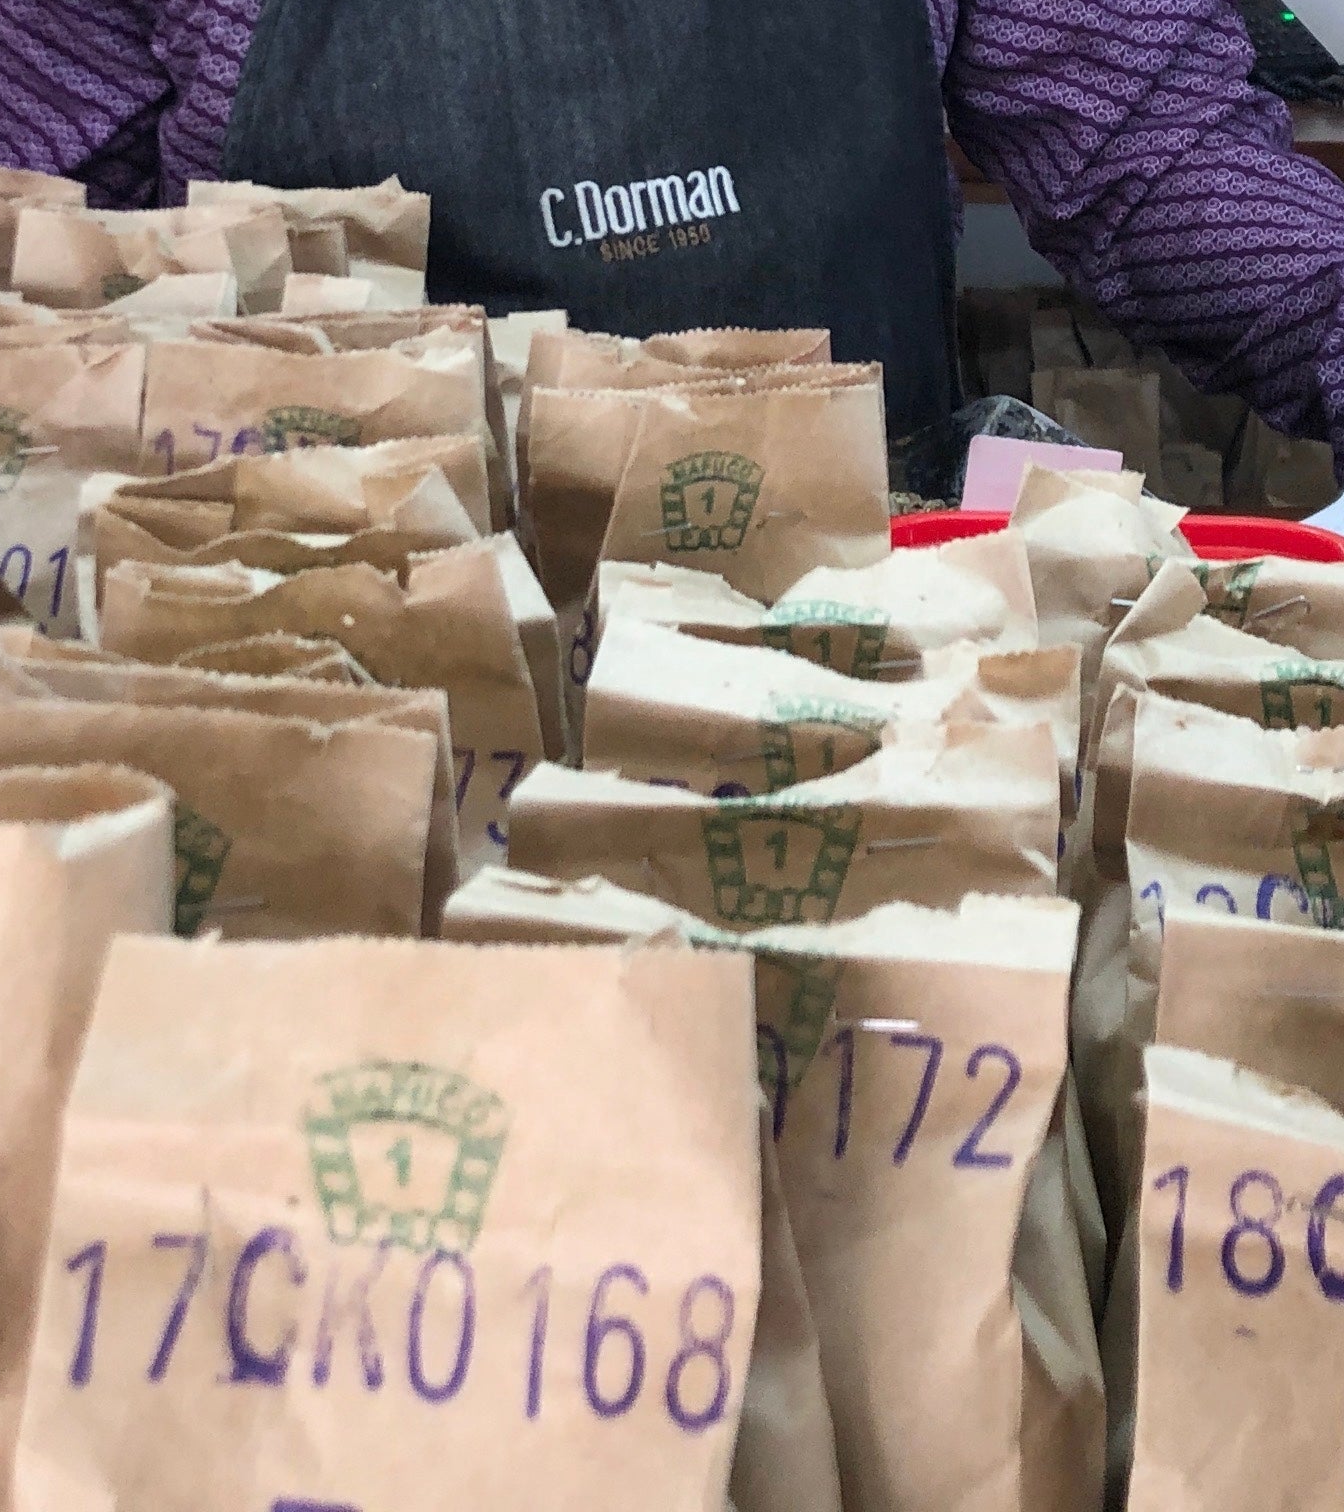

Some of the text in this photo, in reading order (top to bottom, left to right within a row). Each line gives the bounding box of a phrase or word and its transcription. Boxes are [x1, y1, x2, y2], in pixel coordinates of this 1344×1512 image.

[539, 165, 742, 249] C.Dorman
[599, 222, 712, 263] SINCE 1950
[701, 486, 716, 515] 1
[765, 829, 789, 870] 1
[386, 1137, 412, 1187] 1
[65, 1223, 737, 1433] 17CK0168
